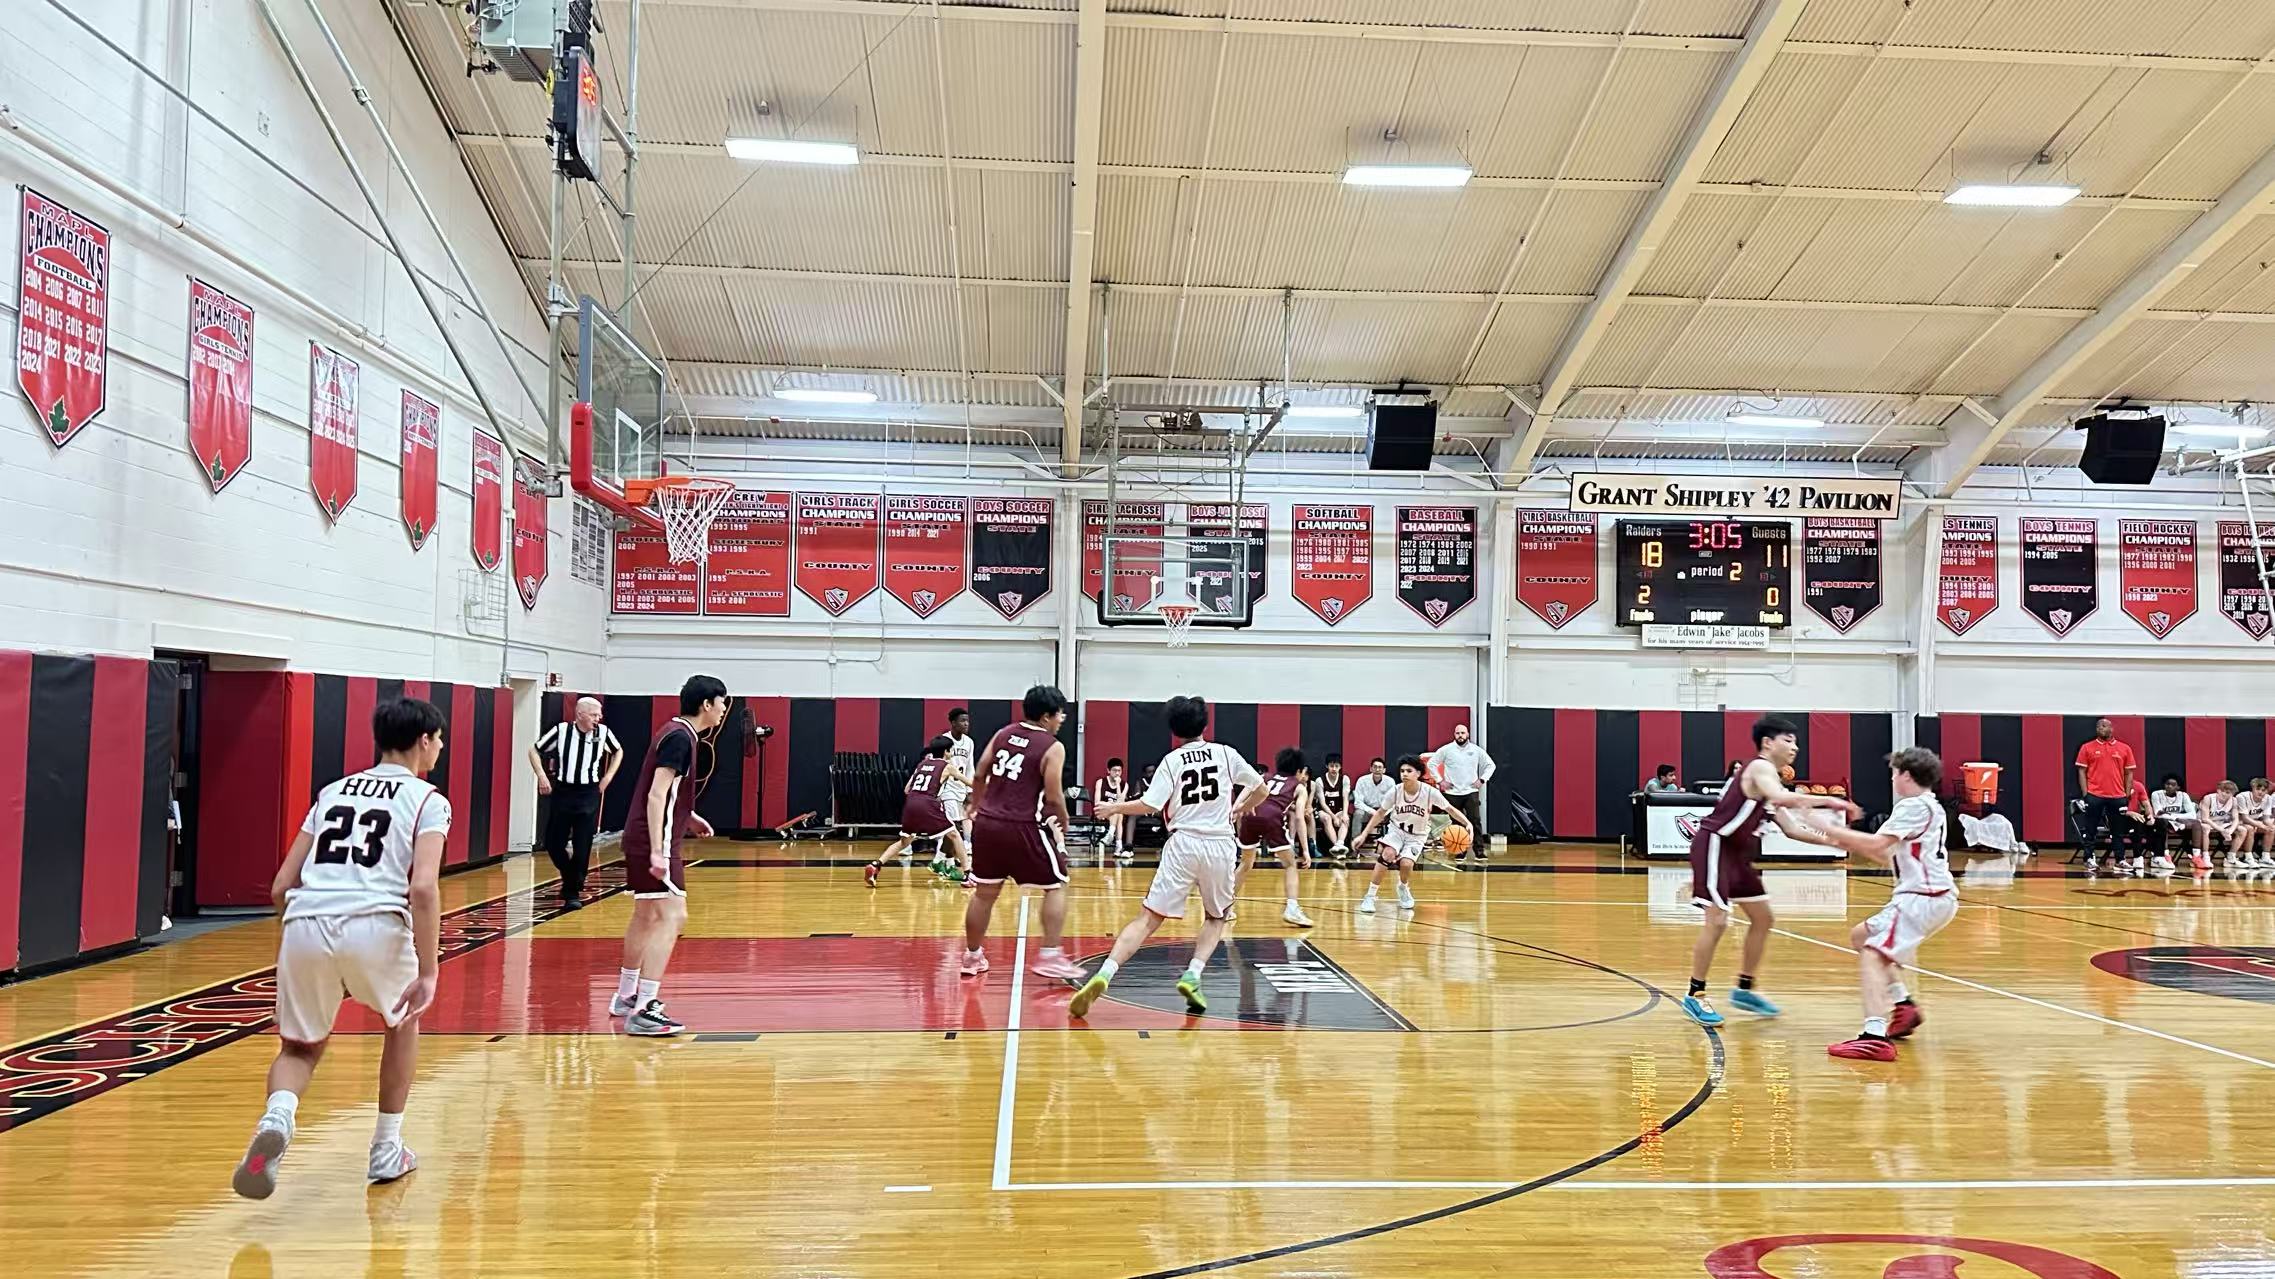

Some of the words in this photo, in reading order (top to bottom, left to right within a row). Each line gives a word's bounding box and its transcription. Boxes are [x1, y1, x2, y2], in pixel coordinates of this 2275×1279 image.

[41, 203, 94, 240] MAPL
[27, 209, 104, 290] CHAMPIONS
[38, 258, 92, 290] FOOTBALL
[86, 295, 103, 318] 2011
[24, 296, 42, 321] 2014
[45, 306, 63, 330] 2015
[66, 315, 82, 338] 2016
[86, 323, 102, 345] 2017
[194, 295, 249, 360] CHAMPIONS
[23, 327, 42, 351] 2018
[45, 336, 60, 359] 2021
[65, 344, 81, 367] 2022
[22, 350, 42, 374] 2024
[733, 492, 766, 502] CREW
[802, 496, 835, 507] GIRLS
[839, 497, 875, 508] TRACK
[1578, 481, 1657, 505] GRANT
[1665, 483, 1755, 508] SHIPLEY
[1799, 486, 1894, 511] PAVILION
[889, 499, 919, 509] GIRLS
[923, 500, 964, 510] SOCCER
[975, 501, 1003, 511] BOYS
[1006, 501, 1049, 513] SOCCER
[1116, 504, 1160, 515] LACROSSE
[802, 509, 875, 519] CHAMPIONS
[890, 512, 961, 521] CHAMPIONS
[1191, 506, 1216, 517] BOYS
[1306, 508, 1360, 519] SOFTBALL
[1409, 510, 1464, 521] BASEBALL
[1522, 512, 1545, 522] GIRLS
[1546, 512, 1593, 523] BASKETBALL
[977, 514, 1047, 524] CHAMPIONS
[1958, 520, 1994, 530] TENNIS
[1298, 521, 1367, 530] CHAMPIONS
[1402, 523, 1471, 532] CHAMPIONS
[1523, 525, 1592, 534] CHAMPIONS
[1626, 524, 1662, 537] Raiders
[2024, 521, 2053, 531] BOYS
[2055, 521, 2093, 532] TENNIS
[2123, 523, 2149, 534] FIELD
[2152, 523, 2192, 534] HOCKEY
[2221, 525, 2242, 536] BOYS
[1689, 522, 1742, 549] 3:05
[1752, 526, 1786, 539] Guests
[1808, 529, 1875, 538] CHAMPIONS
[2026, 534, 2092, 543] CHAMPIONS
[2126, 536, 2190, 545] CHAMPIONS
[1642, 542, 1663, 567] 18
[1767, 544, 1788, 567] 11
[803, 562, 872, 570] COUNTY
[891, 564, 960, 572] COUNTY
[1691, 566, 1723, 578] period
[1729, 562, 1742, 581] 2
[1638, 585, 1651, 604] 2
[1767, 587, 1779, 606] 0
[1691, 609, 1724, 623] player
[1677, 626, 1705, 637] Edwin
[1737, 627, 1765, 639] Jacobs
[1181, 749, 1212, 765] HUN
[992, 749, 1024, 780] 34
[912, 774, 932, 791] 21
[1181, 765, 1219, 806] 25
[340, 778, 402, 800] HUN
[1396, 805, 1425, 817] RAIDERS
[1400, 823, 1414, 834] 11
[314, 805, 392, 868] 23
